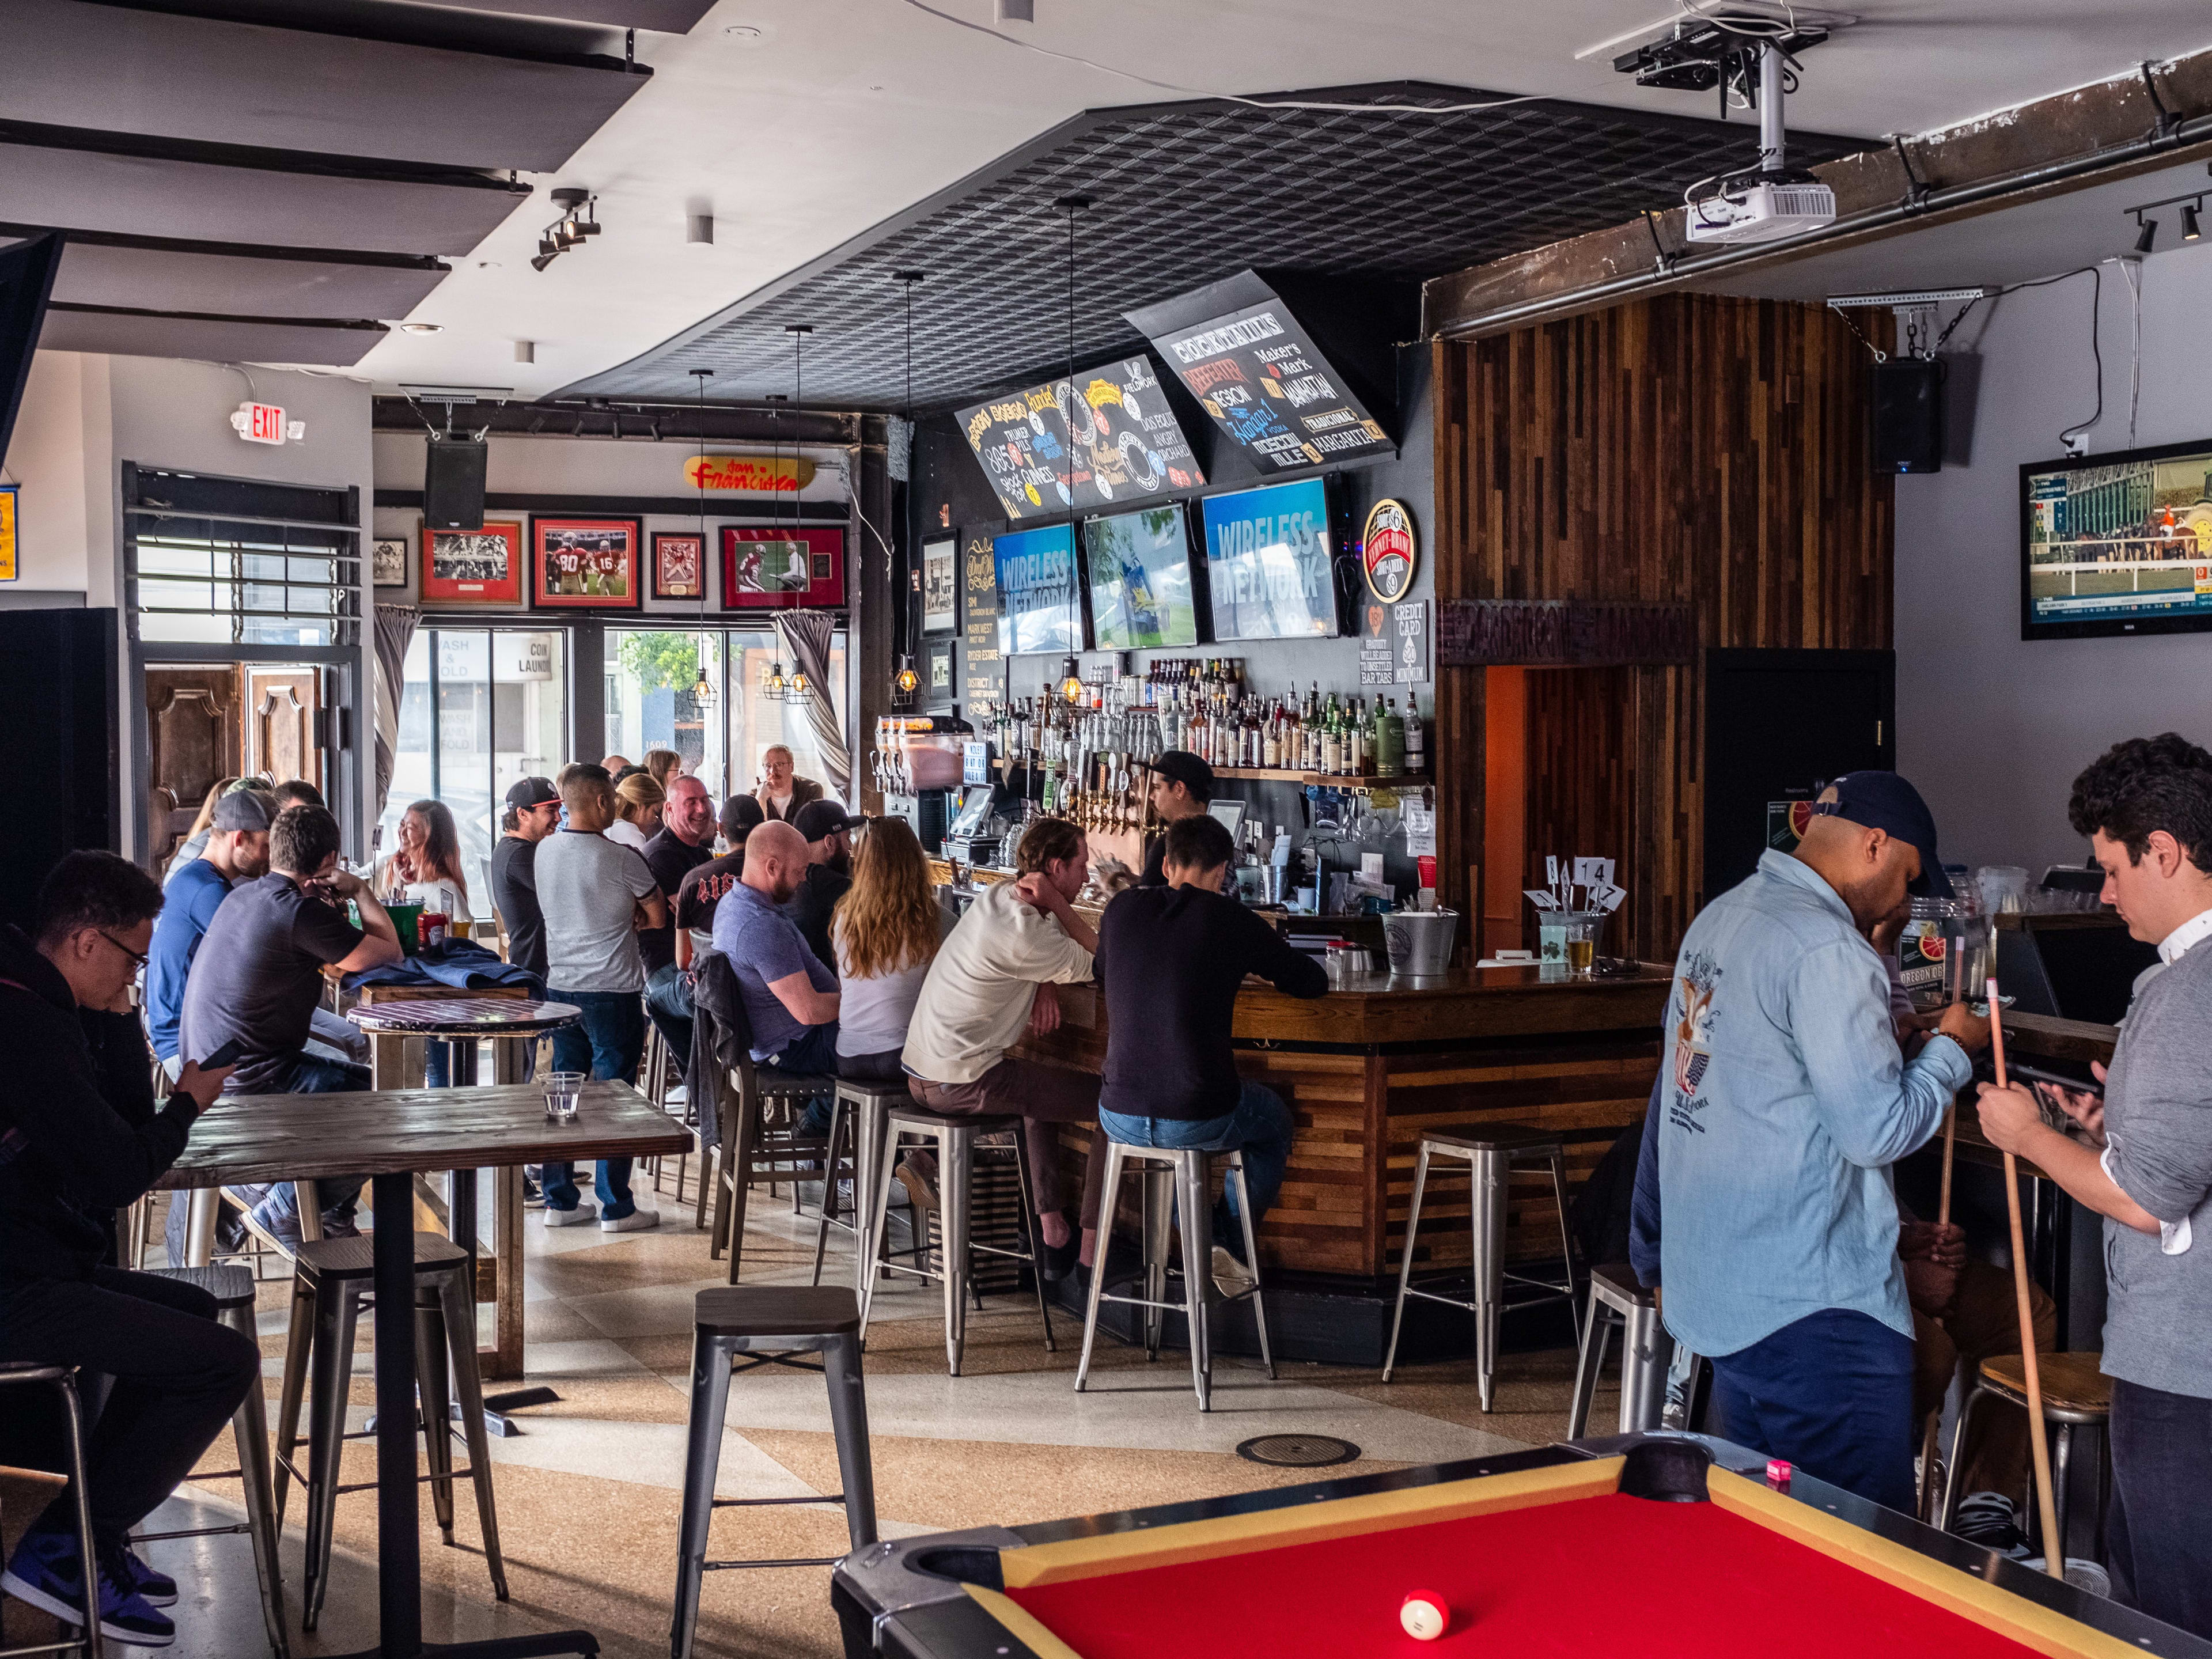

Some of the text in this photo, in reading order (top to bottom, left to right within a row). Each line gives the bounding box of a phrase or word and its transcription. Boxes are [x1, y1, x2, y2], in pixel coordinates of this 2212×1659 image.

[1172, 315, 1283, 362] COCKTAILS
[1253, 343, 1301, 364] Maker's
[1277, 358, 1313, 375] Mark
[1123, 376, 1157, 393] FIELDWORK
[1182, 358, 1250, 396] BEEFEATER
[1209, 385, 1252, 408] NEGRONI
[1278, 372, 1339, 408] MANHATTAN
[253, 405, 281, 440] EXIT
[970, 403, 1027, 449] DRAFT BEERS
[1140, 411, 1177, 432] DOS EQUIS
[1226, 397, 1278, 446] Hangar 1
[1267, 423, 1289, 434] VODKA
[1305, 410, 1356, 430] TRADICIONAL
[1003, 426, 1031, 442] TRUMER
[1153, 429, 1179, 447] ANGRY
[1310, 427, 1376, 453] MARGARITA
[1014, 439, 1032, 452] PILS
[1252, 432, 1303, 455] MOSCOW
[984, 444, 1016, 474] 805
[1157, 444, 1190, 462] ORCHARD
[1271, 449, 1308, 467] MULE
[999, 472, 1023, 493] SHOCK
[1020, 465, 1056, 486] GUINNESS
[1011, 487, 1028, 503] TOP
[1217, 510, 1315, 560] WIRELESS
[1369, 531, 1411, 566] FERNET-BRANC
[559, 554, 613, 573] 80 16
[1002, 550, 1069, 591] WIRELESS
[2198, 567, 2205, 577] 0
[1221, 557, 1319, 605] NETWORK
[1394, 603, 1423, 621] CREDIT
[1398, 620, 1421, 637] CARD
[440, 640, 469, 651] ASH
[1403, 644, 1415, 661] $20
[446, 654, 454, 664] &
[968, 650, 998, 661] RYDER ESTATE
[441, 666, 468, 677] OLD
[1360, 661, 1367, 672] TO
[1396, 666, 1423, 683] MINIMUM
[968, 677, 989, 689] DISTRICT
[1361, 672, 1392, 684] BAR TABS
[440, 714, 471, 724] WASH
[445, 728, 467, 737] AND
[440, 740, 469, 750] FOLD
[646, 740, 668, 749] 1609
[1594, 864, 1605, 882] 4
[1901, 968, 1930, 984] OREGON
